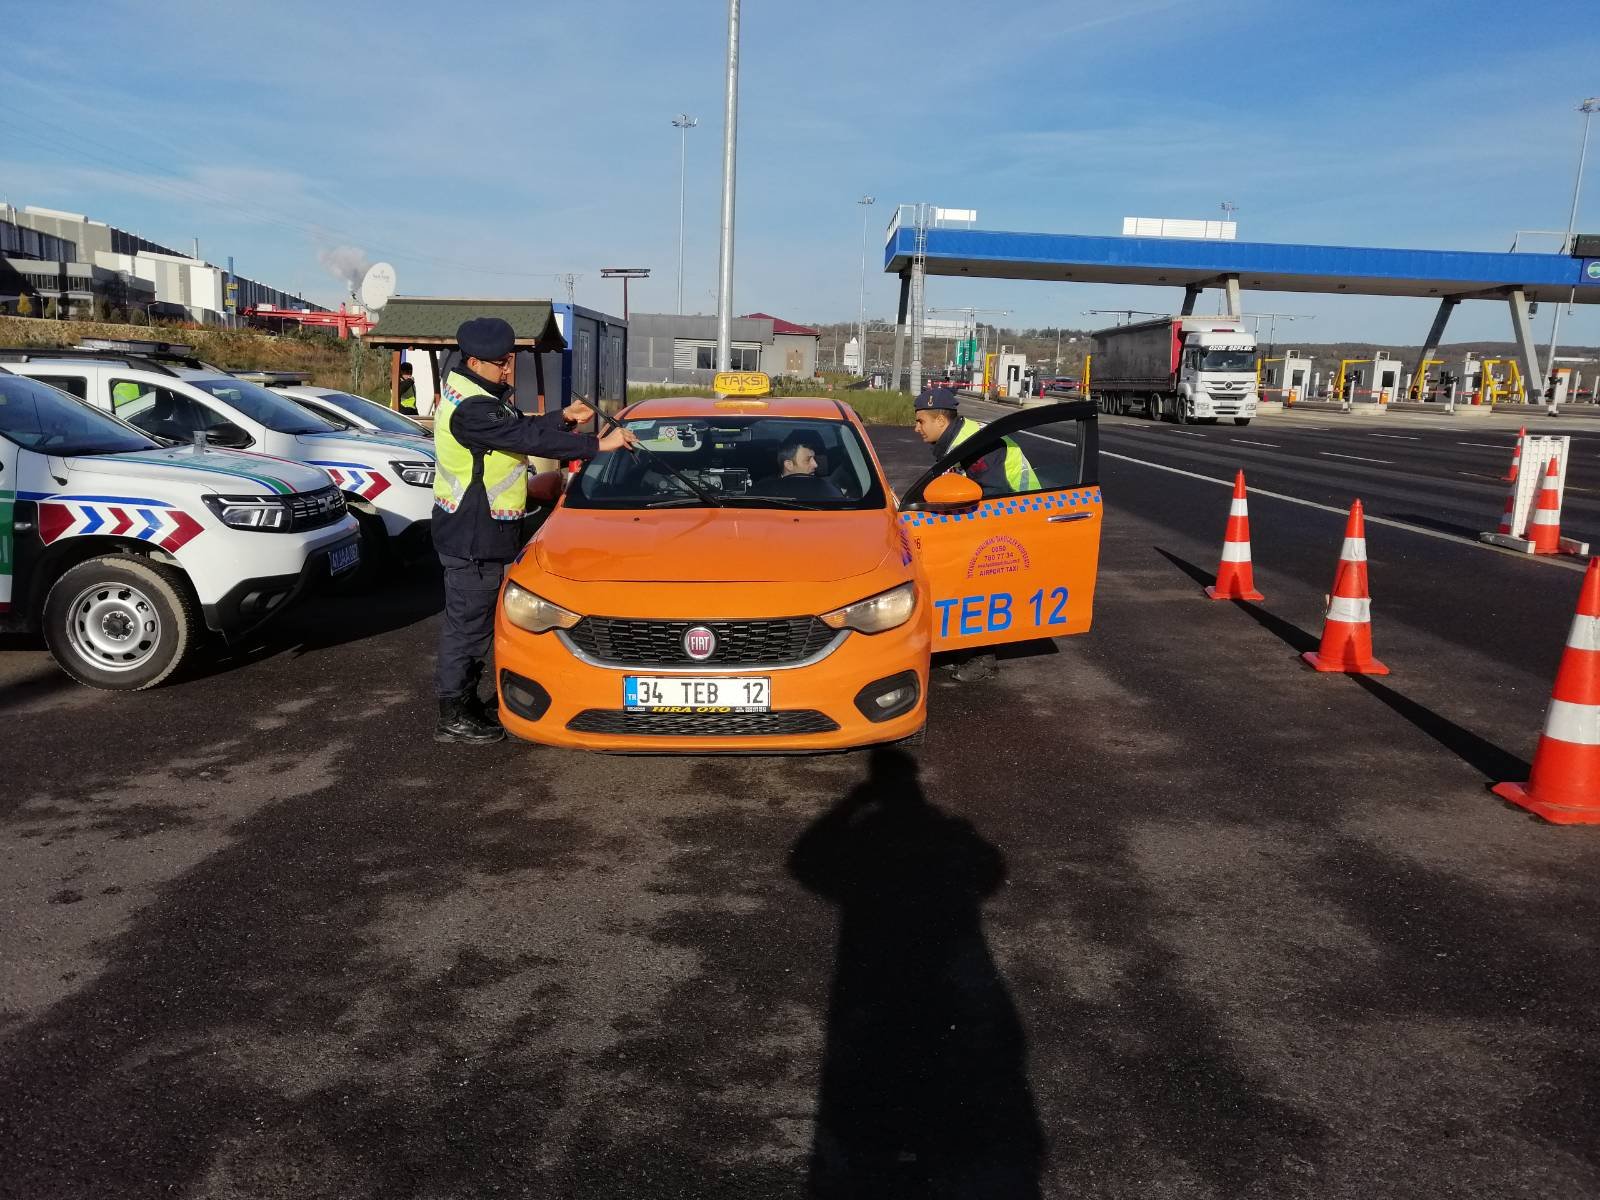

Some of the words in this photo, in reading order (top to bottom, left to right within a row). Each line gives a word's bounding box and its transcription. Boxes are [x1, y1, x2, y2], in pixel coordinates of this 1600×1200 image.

[980, 567, 1004, 576] AIRPORT
[1006, 565, 1018, 573] TAXI
[934, 592, 1013, 637] TEB
[1029, 586, 1069, 626] 12
[691, 636, 709, 650] FIAT
[639, 682, 663, 704] 34
[680, 682, 719, 704] TEB
[743, 682, 764, 704] 12
